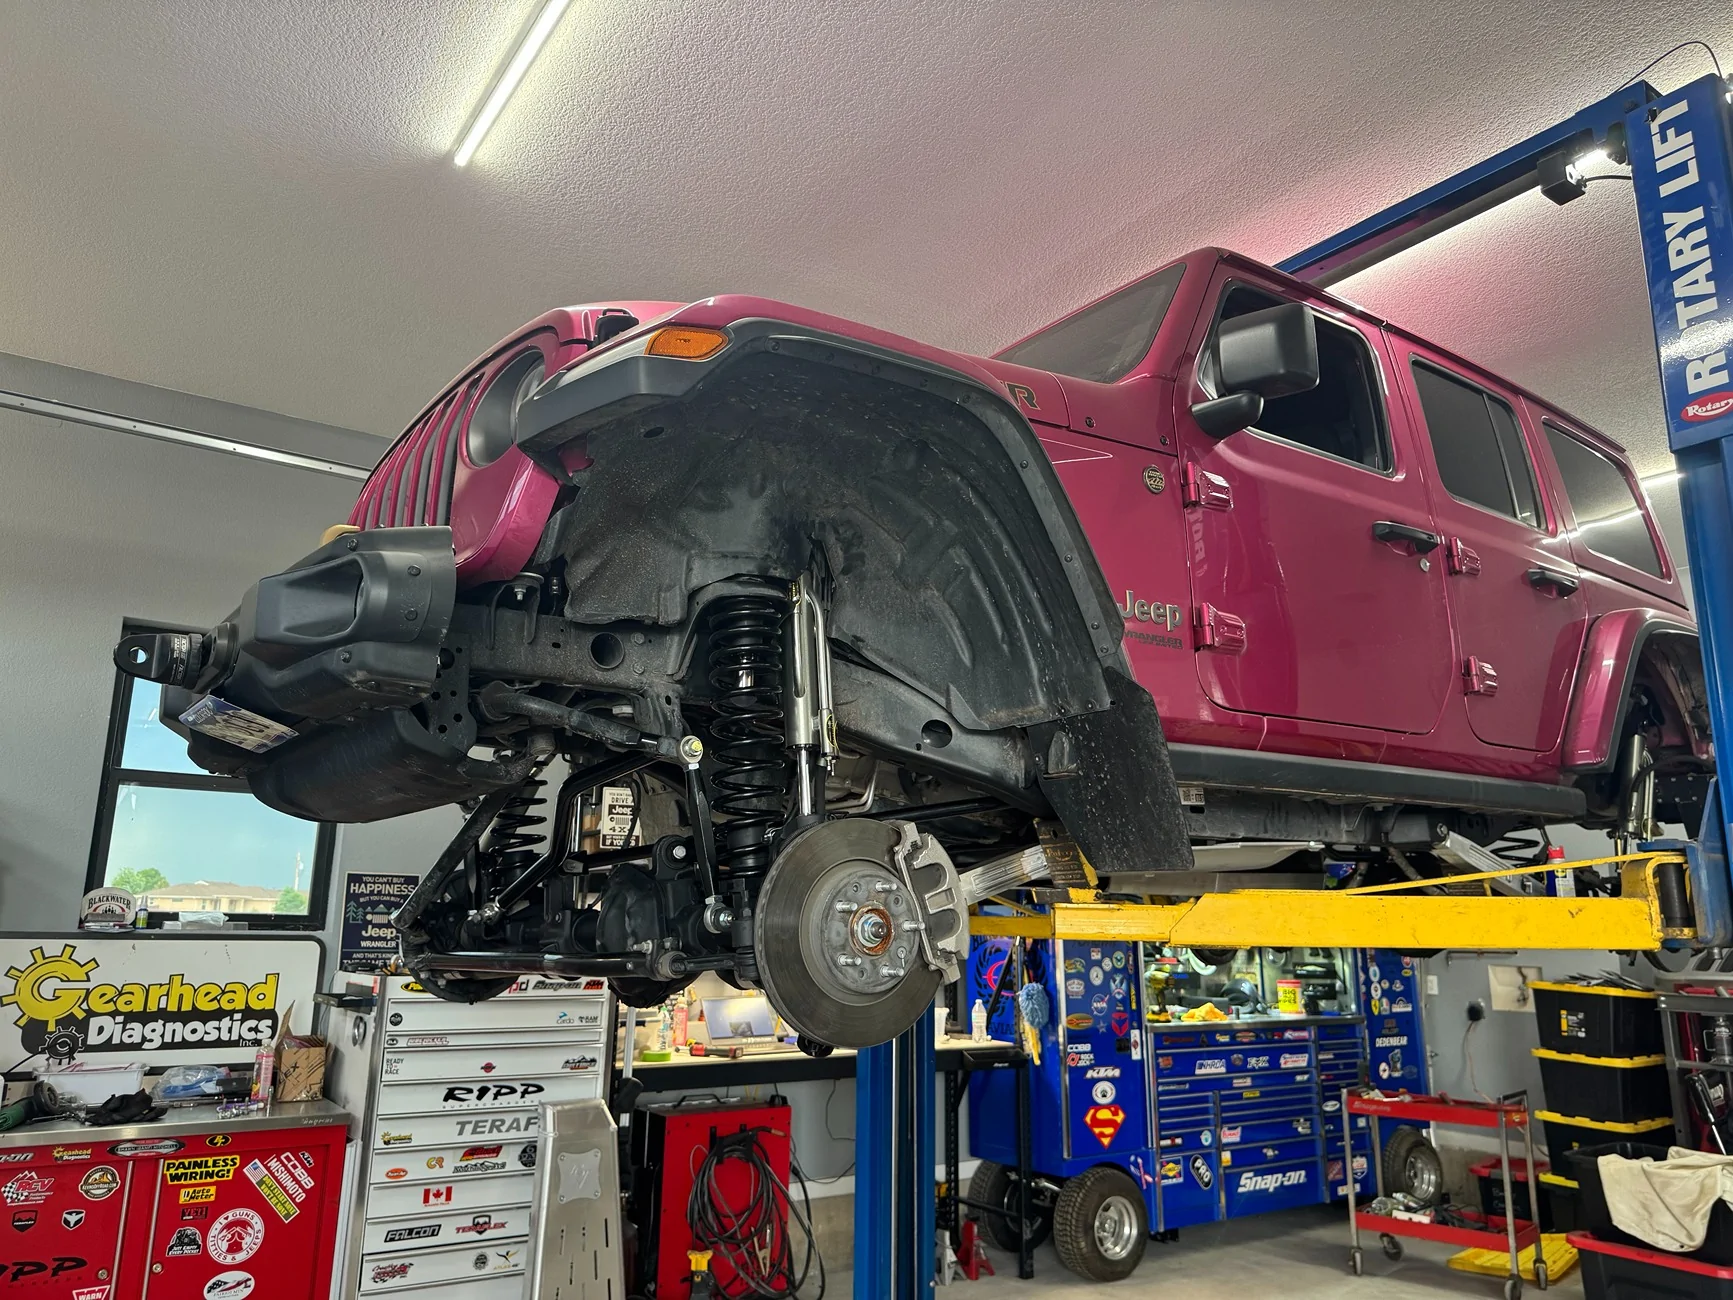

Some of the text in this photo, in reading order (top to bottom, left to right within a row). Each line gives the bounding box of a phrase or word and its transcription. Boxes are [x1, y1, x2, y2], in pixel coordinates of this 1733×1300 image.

[1650, 99, 1700, 198] LIFT
[1117, 589, 1183, 632] Jeep
[350, 883, 415, 895] HAPPINESS
[88, 895, 131, 910] BLACKWATER
[361, 924, 396, 940] Jeep
[360, 940, 397, 948] WRANGLER
[2, 944, 280, 1031] Gearhead
[86, 1015, 274, 1050] Diagnostics
[239, 1038, 258, 1048] Inc.
[1085, 1066, 1121, 1079] KTM
[442, 1083, 545, 1102] RIPP
[442, 1100, 536, 1109] SUPERCHARGER
[456, 1117, 538, 1136] TERAF
[166, 1157, 238, 1172] PAINLESS
[300, 1151, 314, 1167] KTM
[168, 1168, 231, 1182] WIRING!
[280, 1152, 315, 1189] COBB
[1194, 1159, 1211, 1184] PRO
[15, 1178, 54, 1192] RCV
[267, 1157, 306, 1203] MISHIMOTO
[1237, 1170, 1307, 1193] Snap-on
[188, 1192, 214, 1201] Meter
[191, 1187, 211, 1195] Auto
[231, 1211, 255, 1221] GUNS
[386, 1225, 439, 1241] FALCON
[455, 1221, 508, 1234] TERAFLEX
[210, 1235, 227, 1261] TITTIES
[245, 1228, 262, 1256] JEEPS
[0, 1256, 88, 1283] PP
[78, 1291, 102, 1300] WARN
